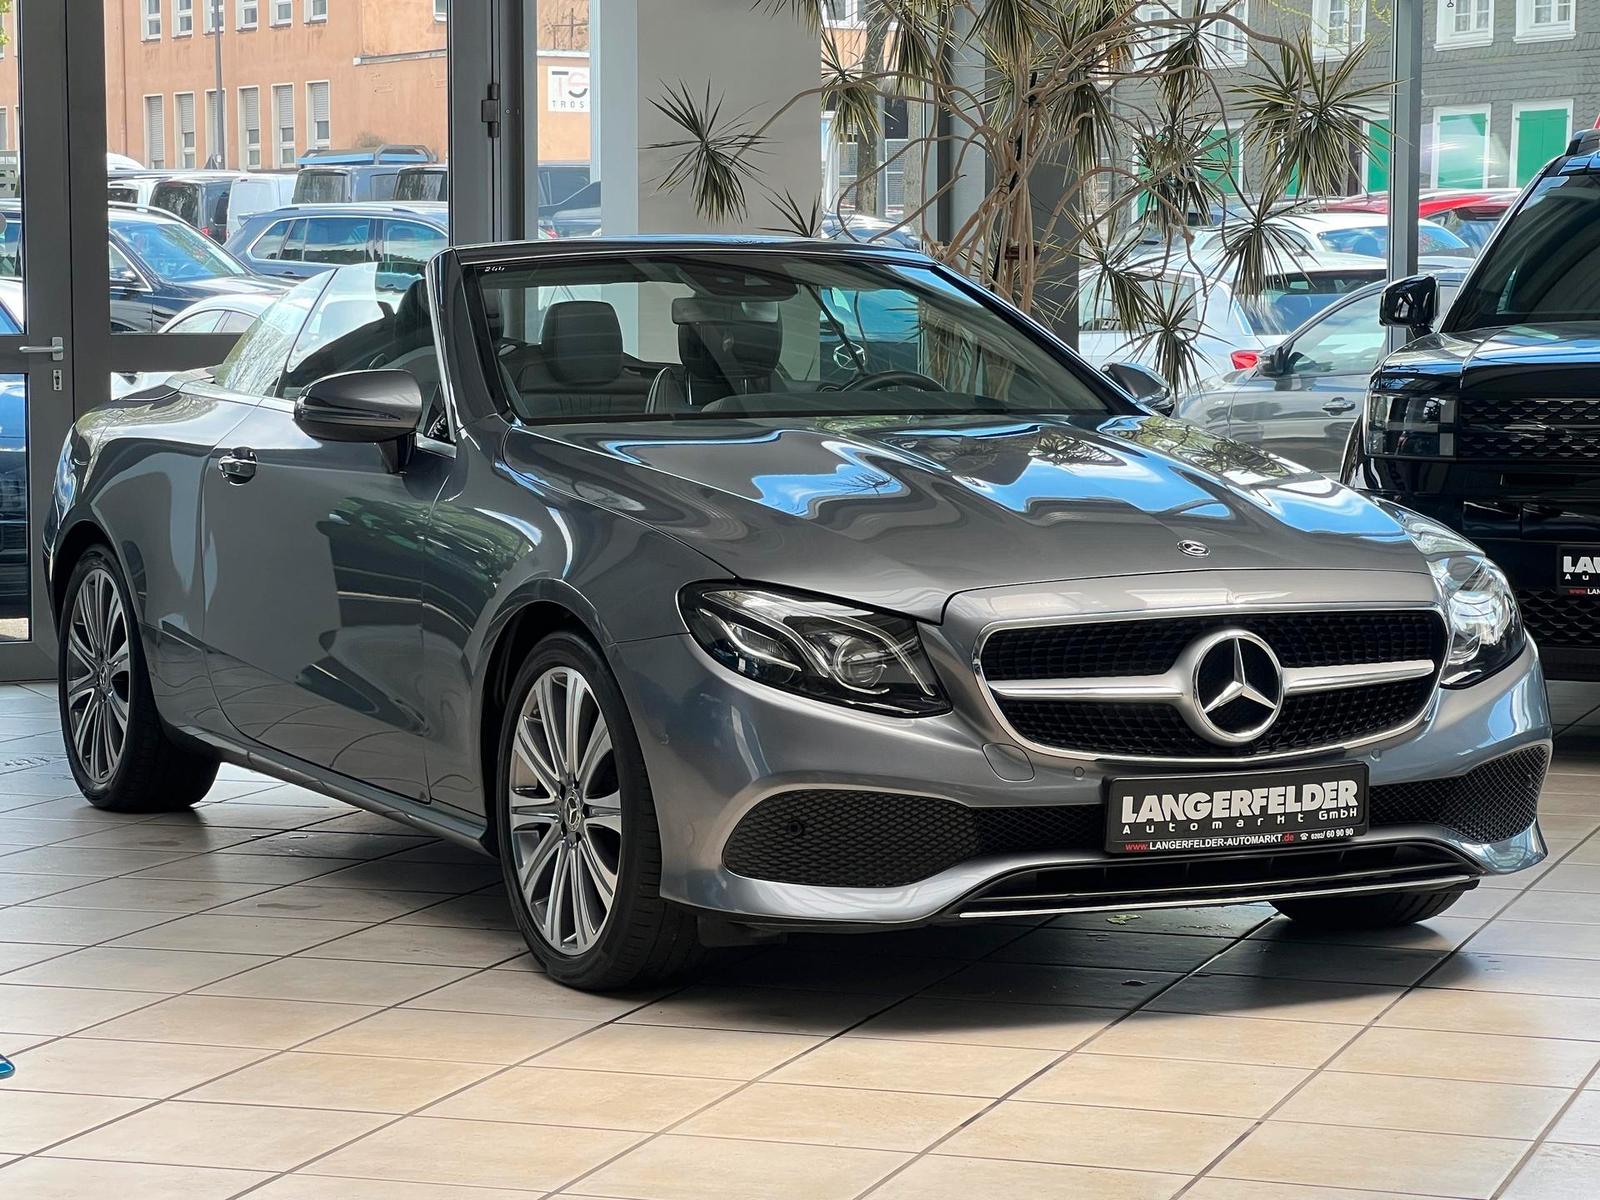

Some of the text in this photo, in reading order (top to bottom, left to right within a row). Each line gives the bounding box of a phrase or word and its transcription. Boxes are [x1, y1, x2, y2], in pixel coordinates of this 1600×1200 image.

[1121, 780, 1358, 824] LANGERFELDER
[1318, 808, 1358, 821] GmbH
[1125, 833, 1295, 851] www.LANGERFELDER-AUTOMARKT.de
[1326, 830, 1335, 838] 60
[1336, 829, 1344, 837] 90
[1345, 828, 1354, 836] 90
